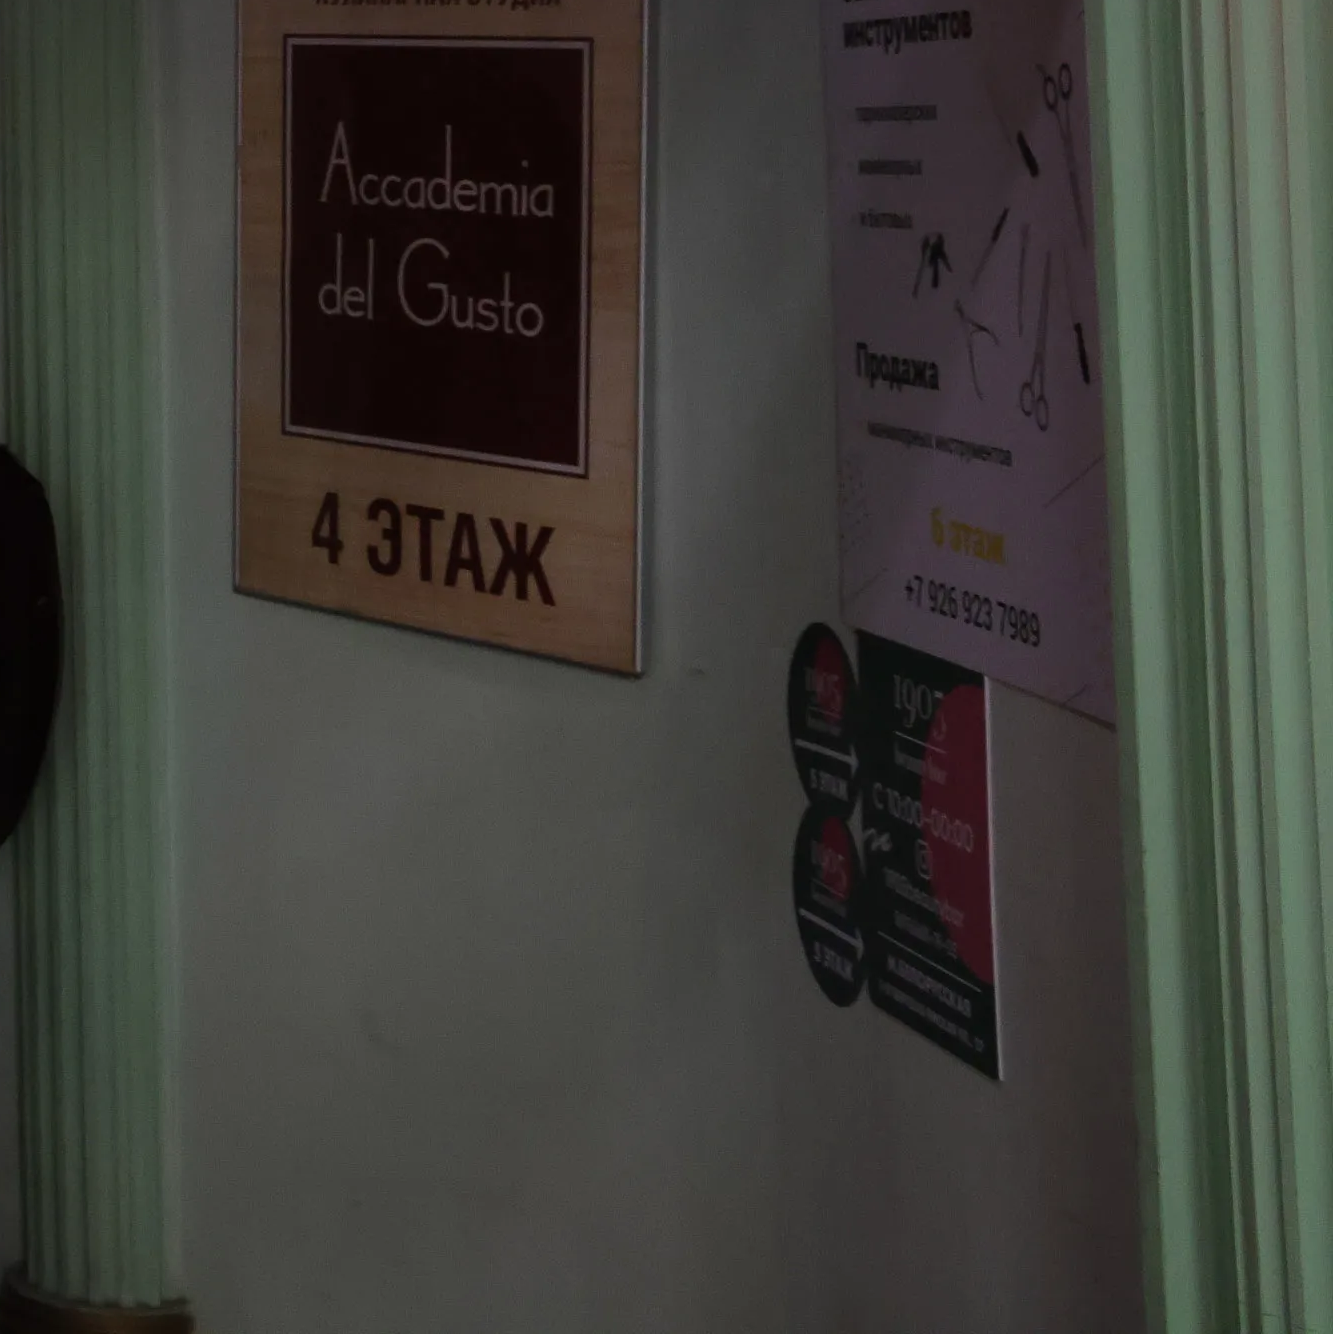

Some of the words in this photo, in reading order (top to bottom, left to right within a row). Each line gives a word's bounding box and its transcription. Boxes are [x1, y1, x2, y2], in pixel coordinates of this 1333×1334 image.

[843, 9, 973, 54] инструментов
[320, 122, 554, 218] Accademia
[318, 233, 374, 320] del
[397, 238, 544, 338] Gusto
[856, 342, 940, 392] Продажа
[312, 492, 344, 565] 4
[366, 498, 555, 606] ЭТАЖ
[905, 575, 923, 607] +7
[928, 580, 958, 619] 926
[963, 591, 993, 631] 923
[997, 602, 1040, 647] 7989
